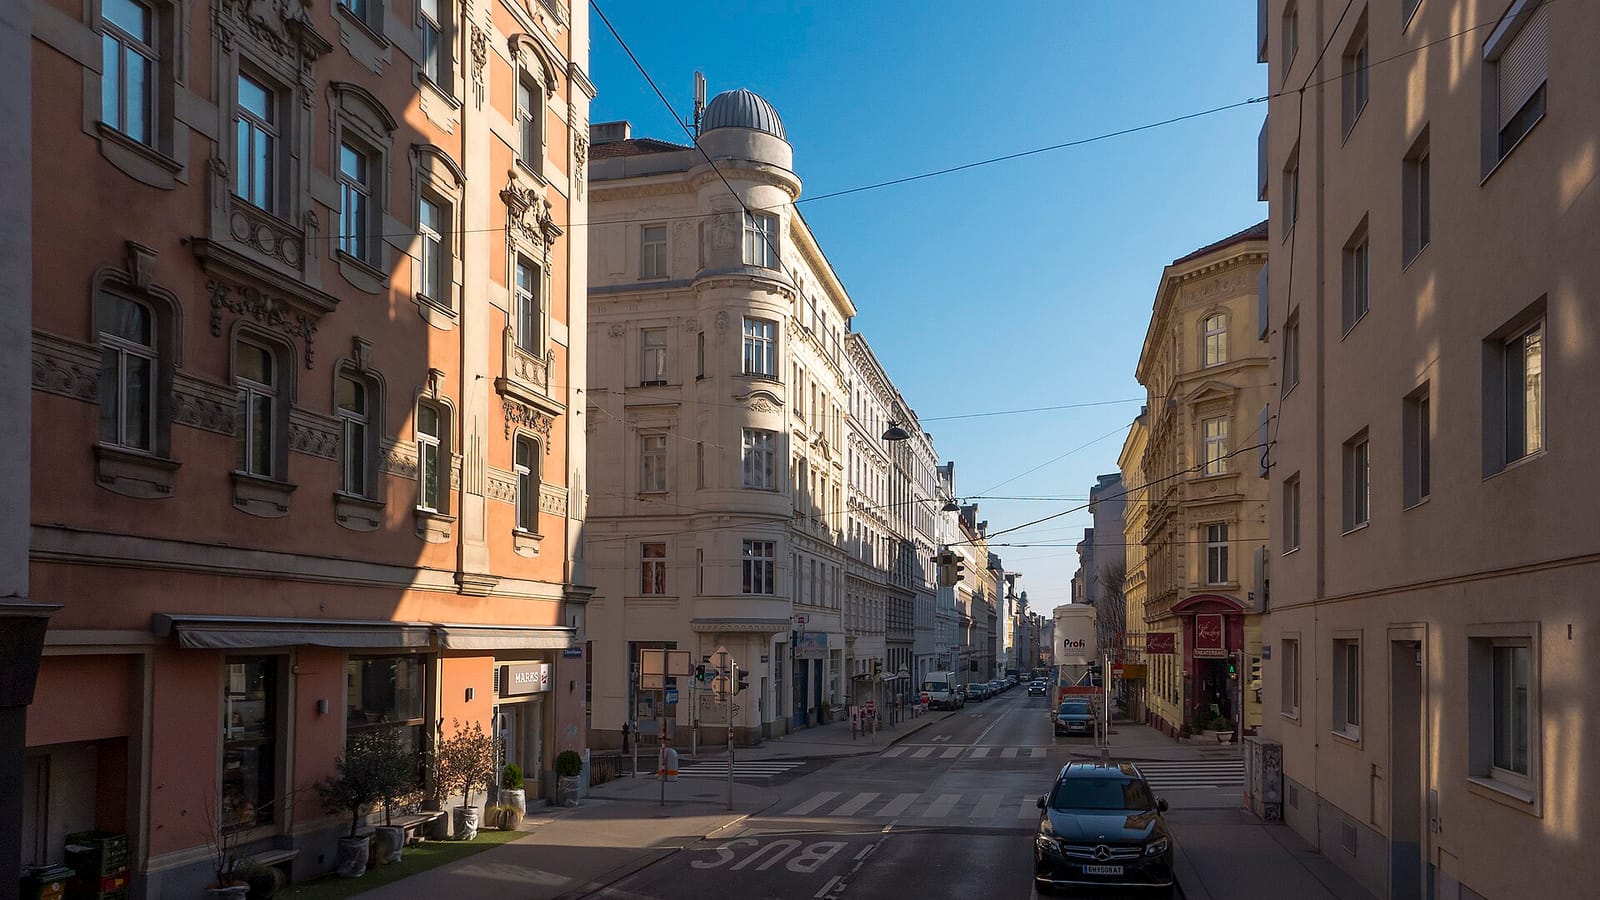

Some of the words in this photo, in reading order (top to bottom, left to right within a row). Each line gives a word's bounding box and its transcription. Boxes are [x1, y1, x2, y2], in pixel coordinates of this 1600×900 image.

[1064, 638, 1085, 648] Profi
[515, 671, 539, 684] MARKS
[690, 838, 849, 873] BUS
